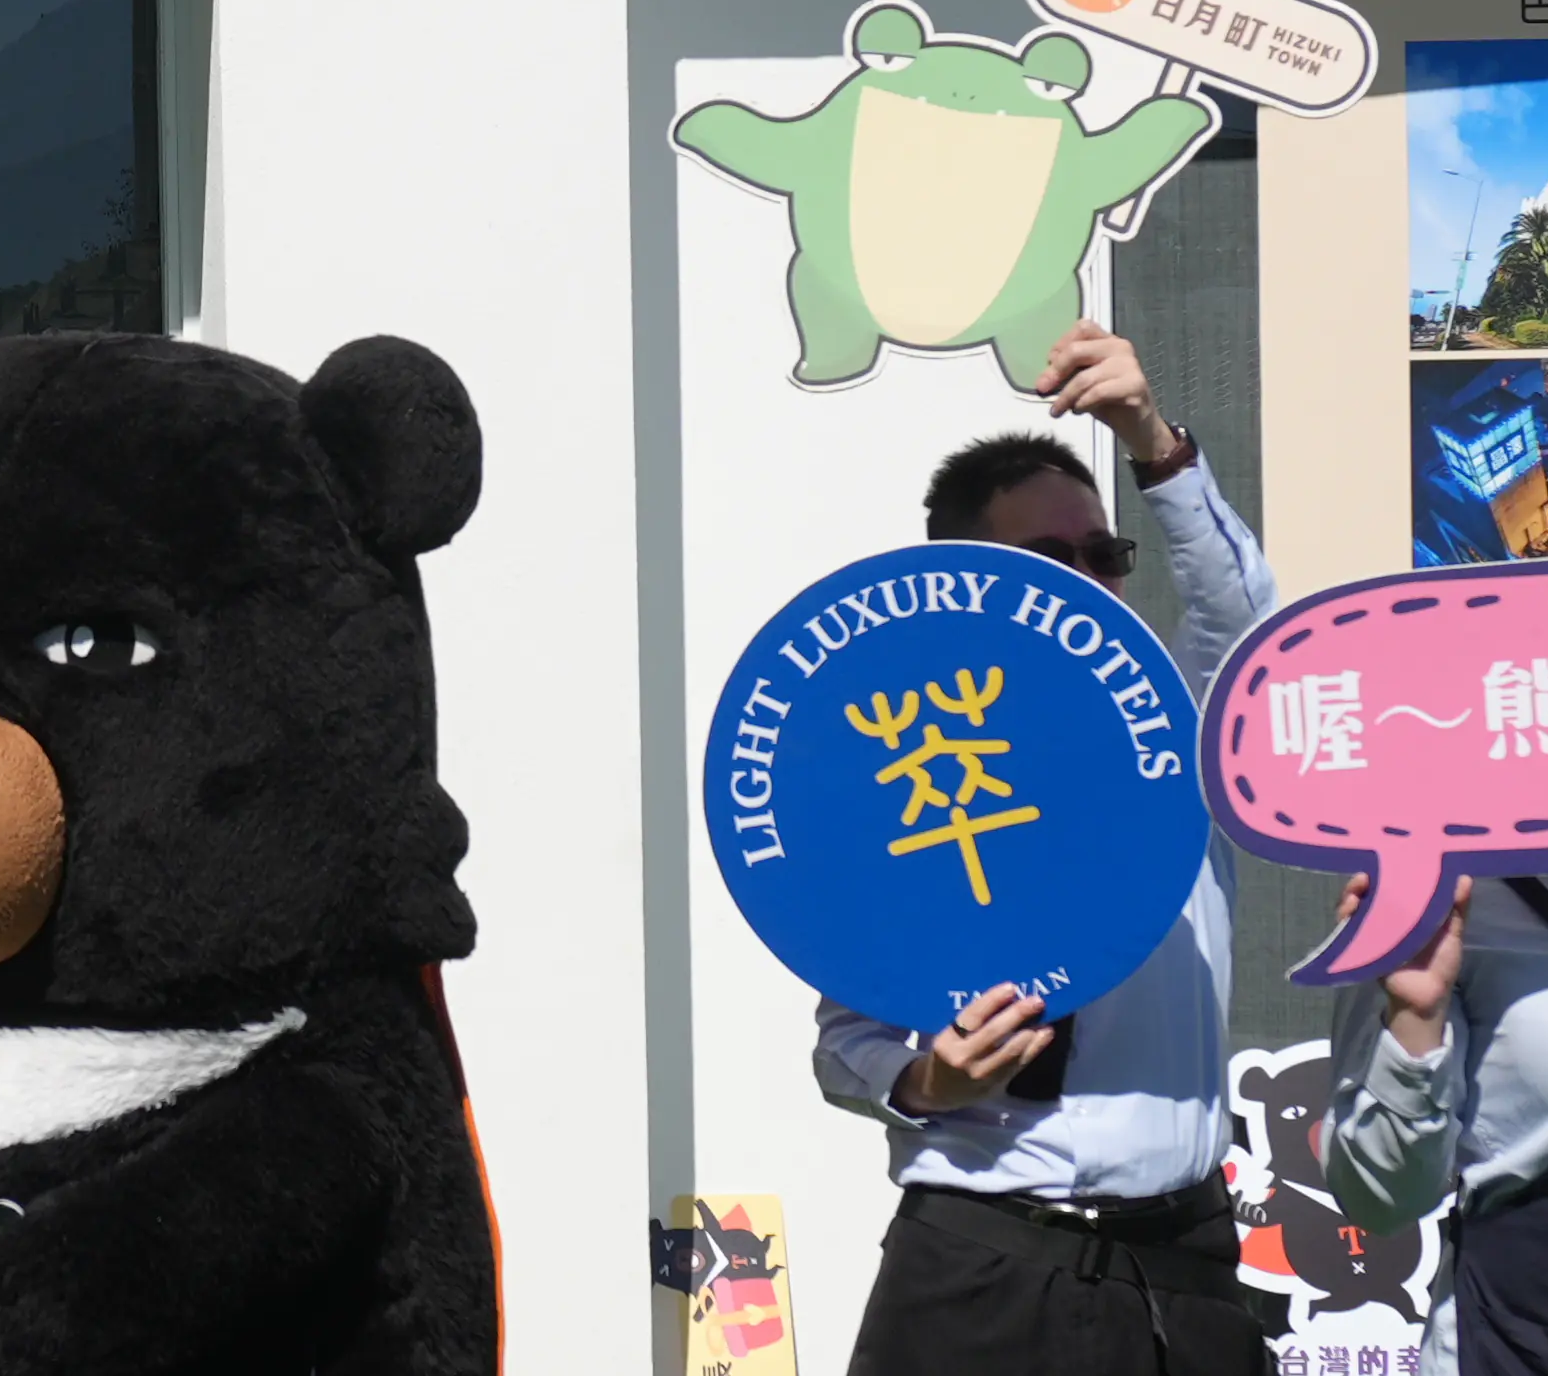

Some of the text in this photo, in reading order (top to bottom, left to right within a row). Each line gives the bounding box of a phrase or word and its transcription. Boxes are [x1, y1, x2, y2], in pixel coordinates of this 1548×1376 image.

[1267, 45, 1323, 78] TOWN
[1272, 26, 1342, 63] HIZUKI
[730, 570, 1183, 869] LIGHT LUXURY HOTELS
